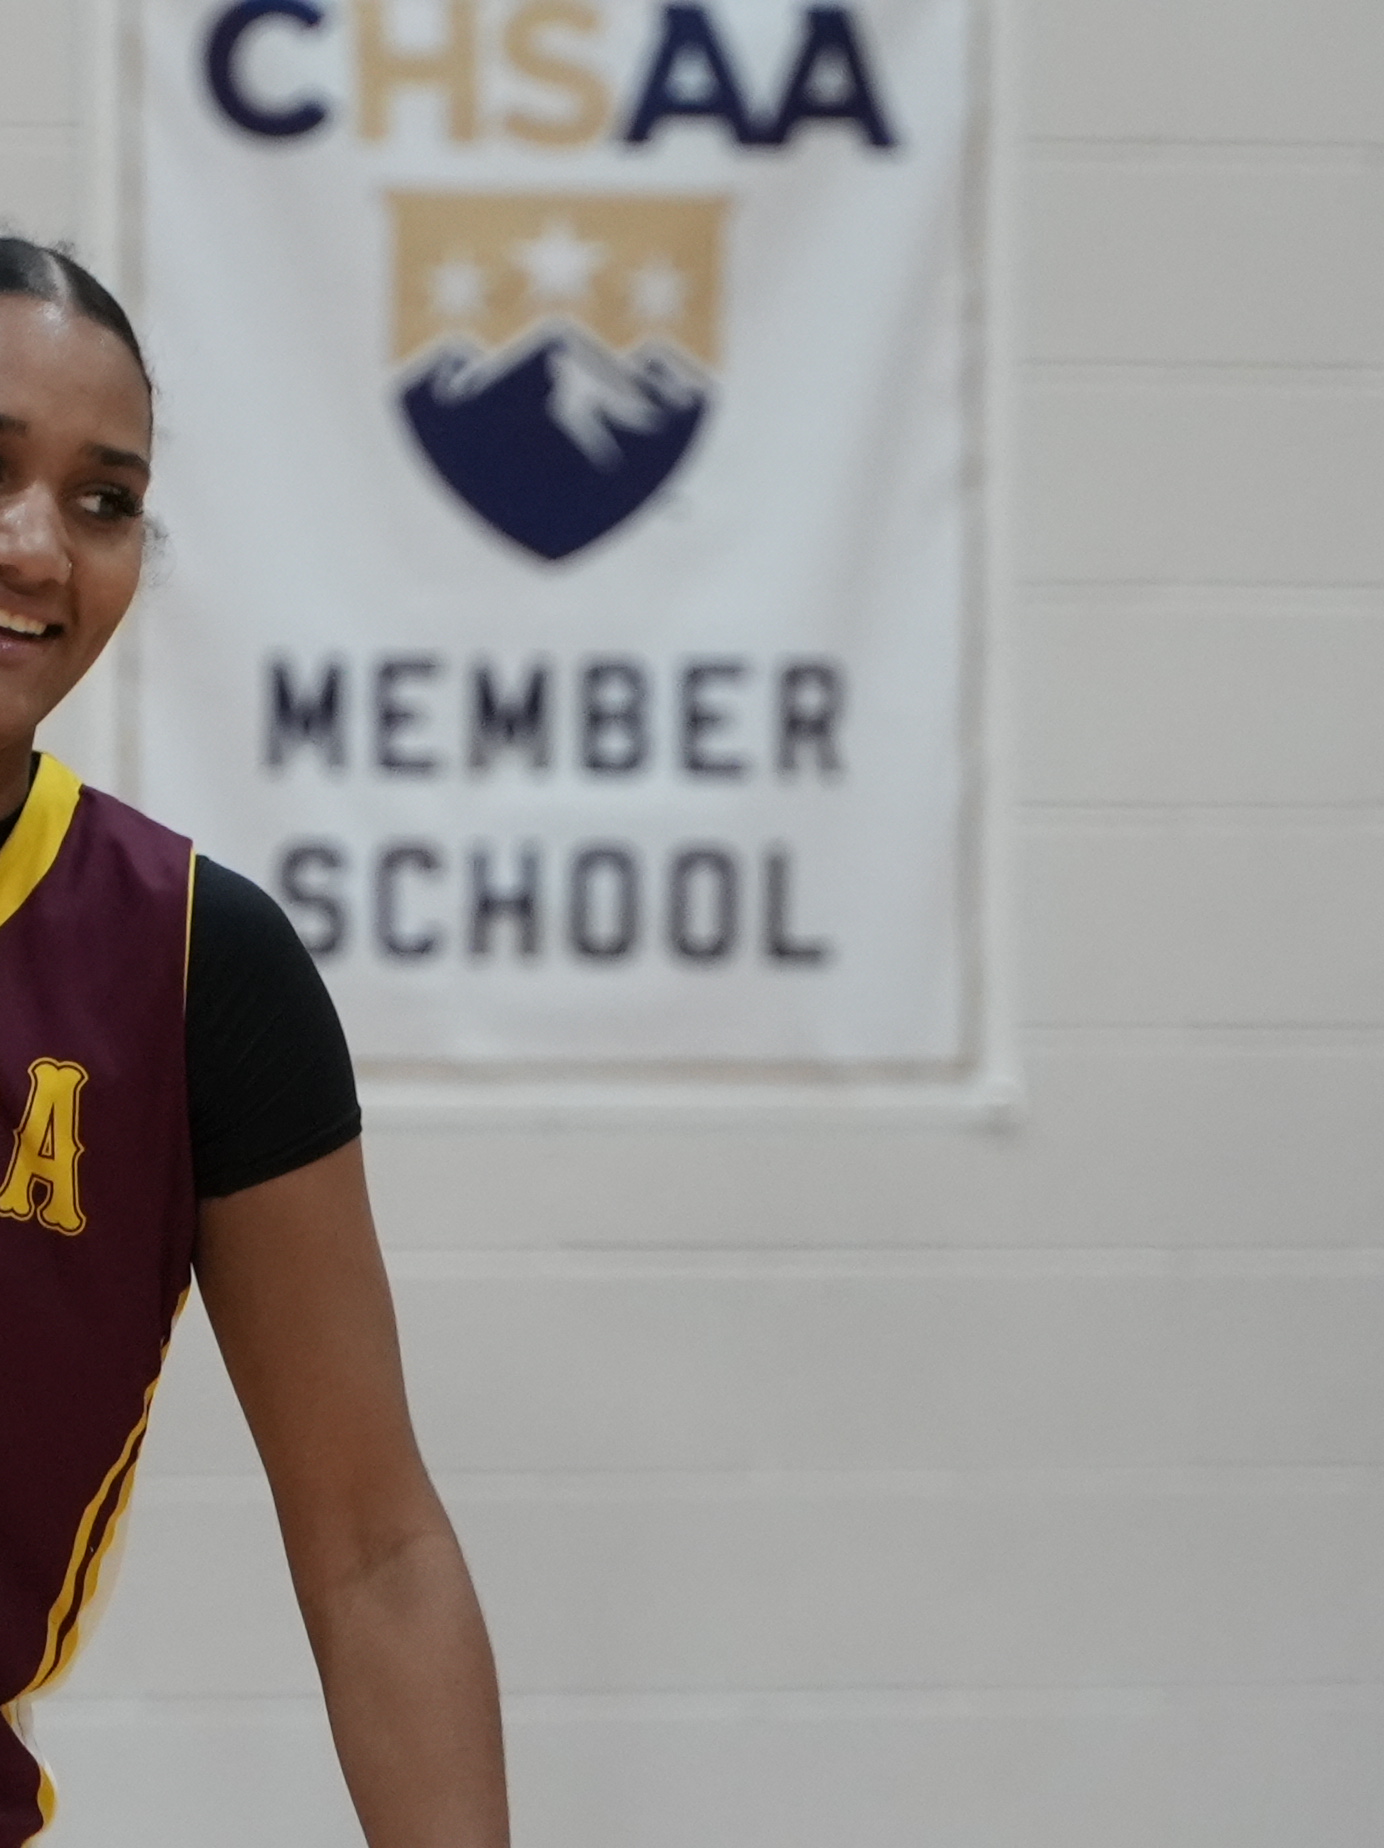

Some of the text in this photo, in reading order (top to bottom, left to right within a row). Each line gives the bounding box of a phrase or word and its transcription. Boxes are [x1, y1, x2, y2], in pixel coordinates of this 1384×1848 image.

[203, 0, 898, 147] CHSAA
[262, 652, 849, 778] MEMBER
[276, 838, 830, 968] SCHOOL
